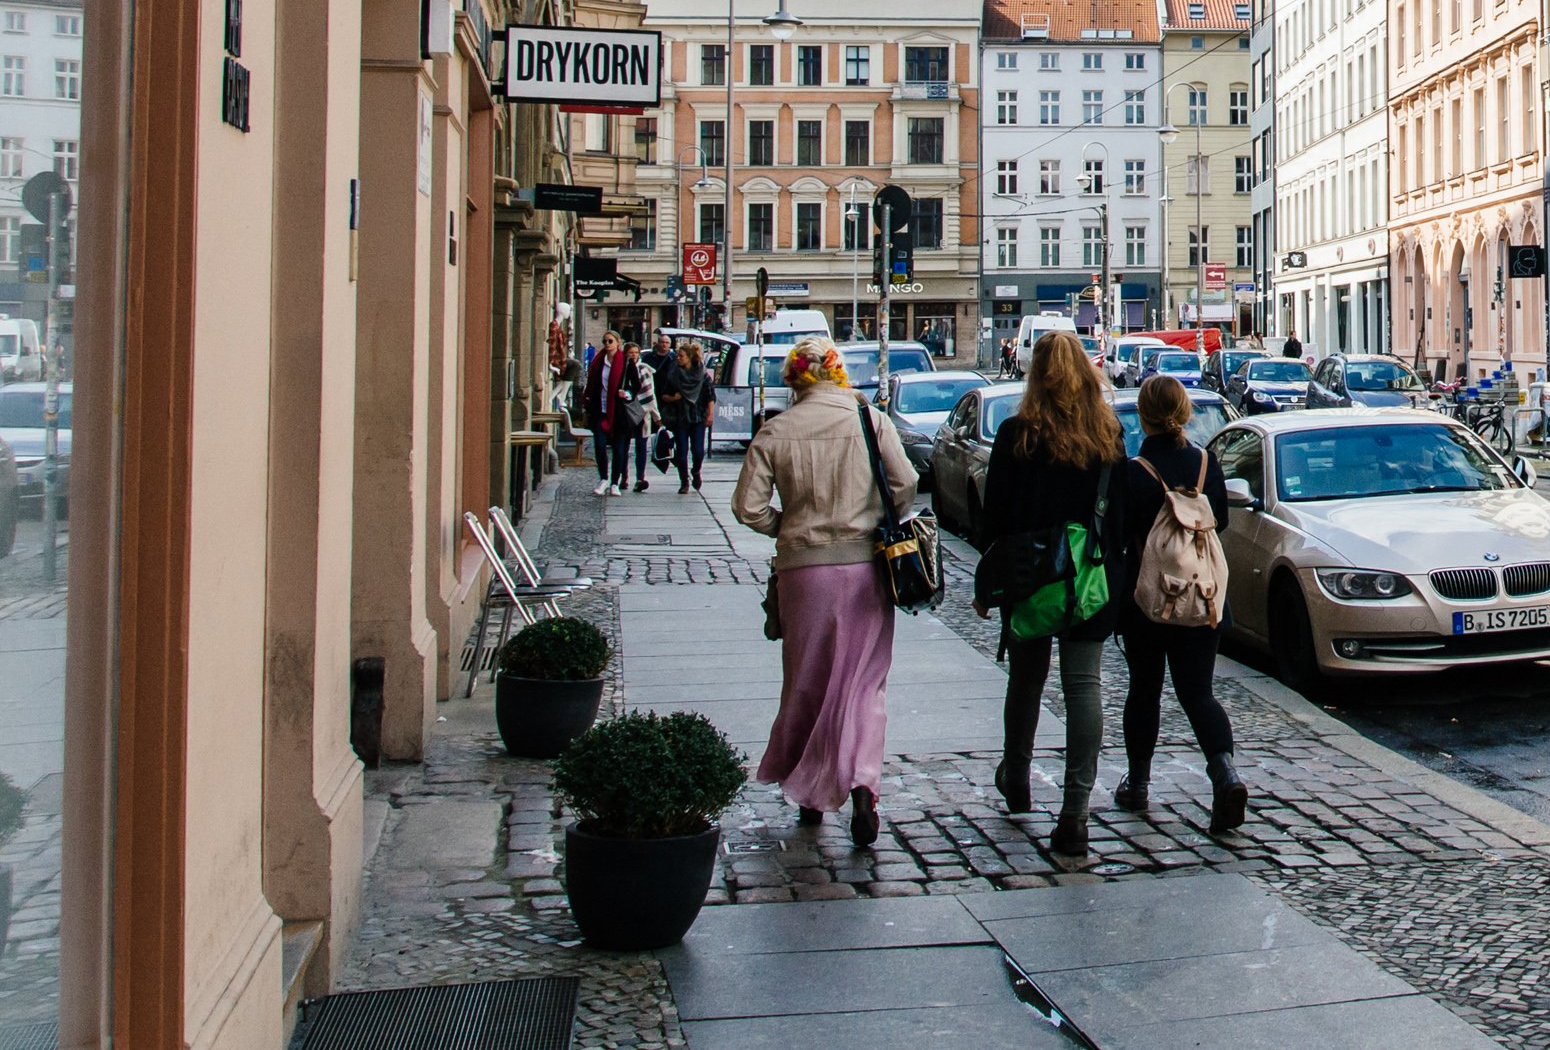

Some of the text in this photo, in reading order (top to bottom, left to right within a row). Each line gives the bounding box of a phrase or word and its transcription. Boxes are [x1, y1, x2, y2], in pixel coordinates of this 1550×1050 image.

[517, 39, 649, 86] DRYKORN
[866, 283, 924, 294] MNGO
[1002, 304, 1013, 312] 33
[1464, 614, 1475, 631] B
